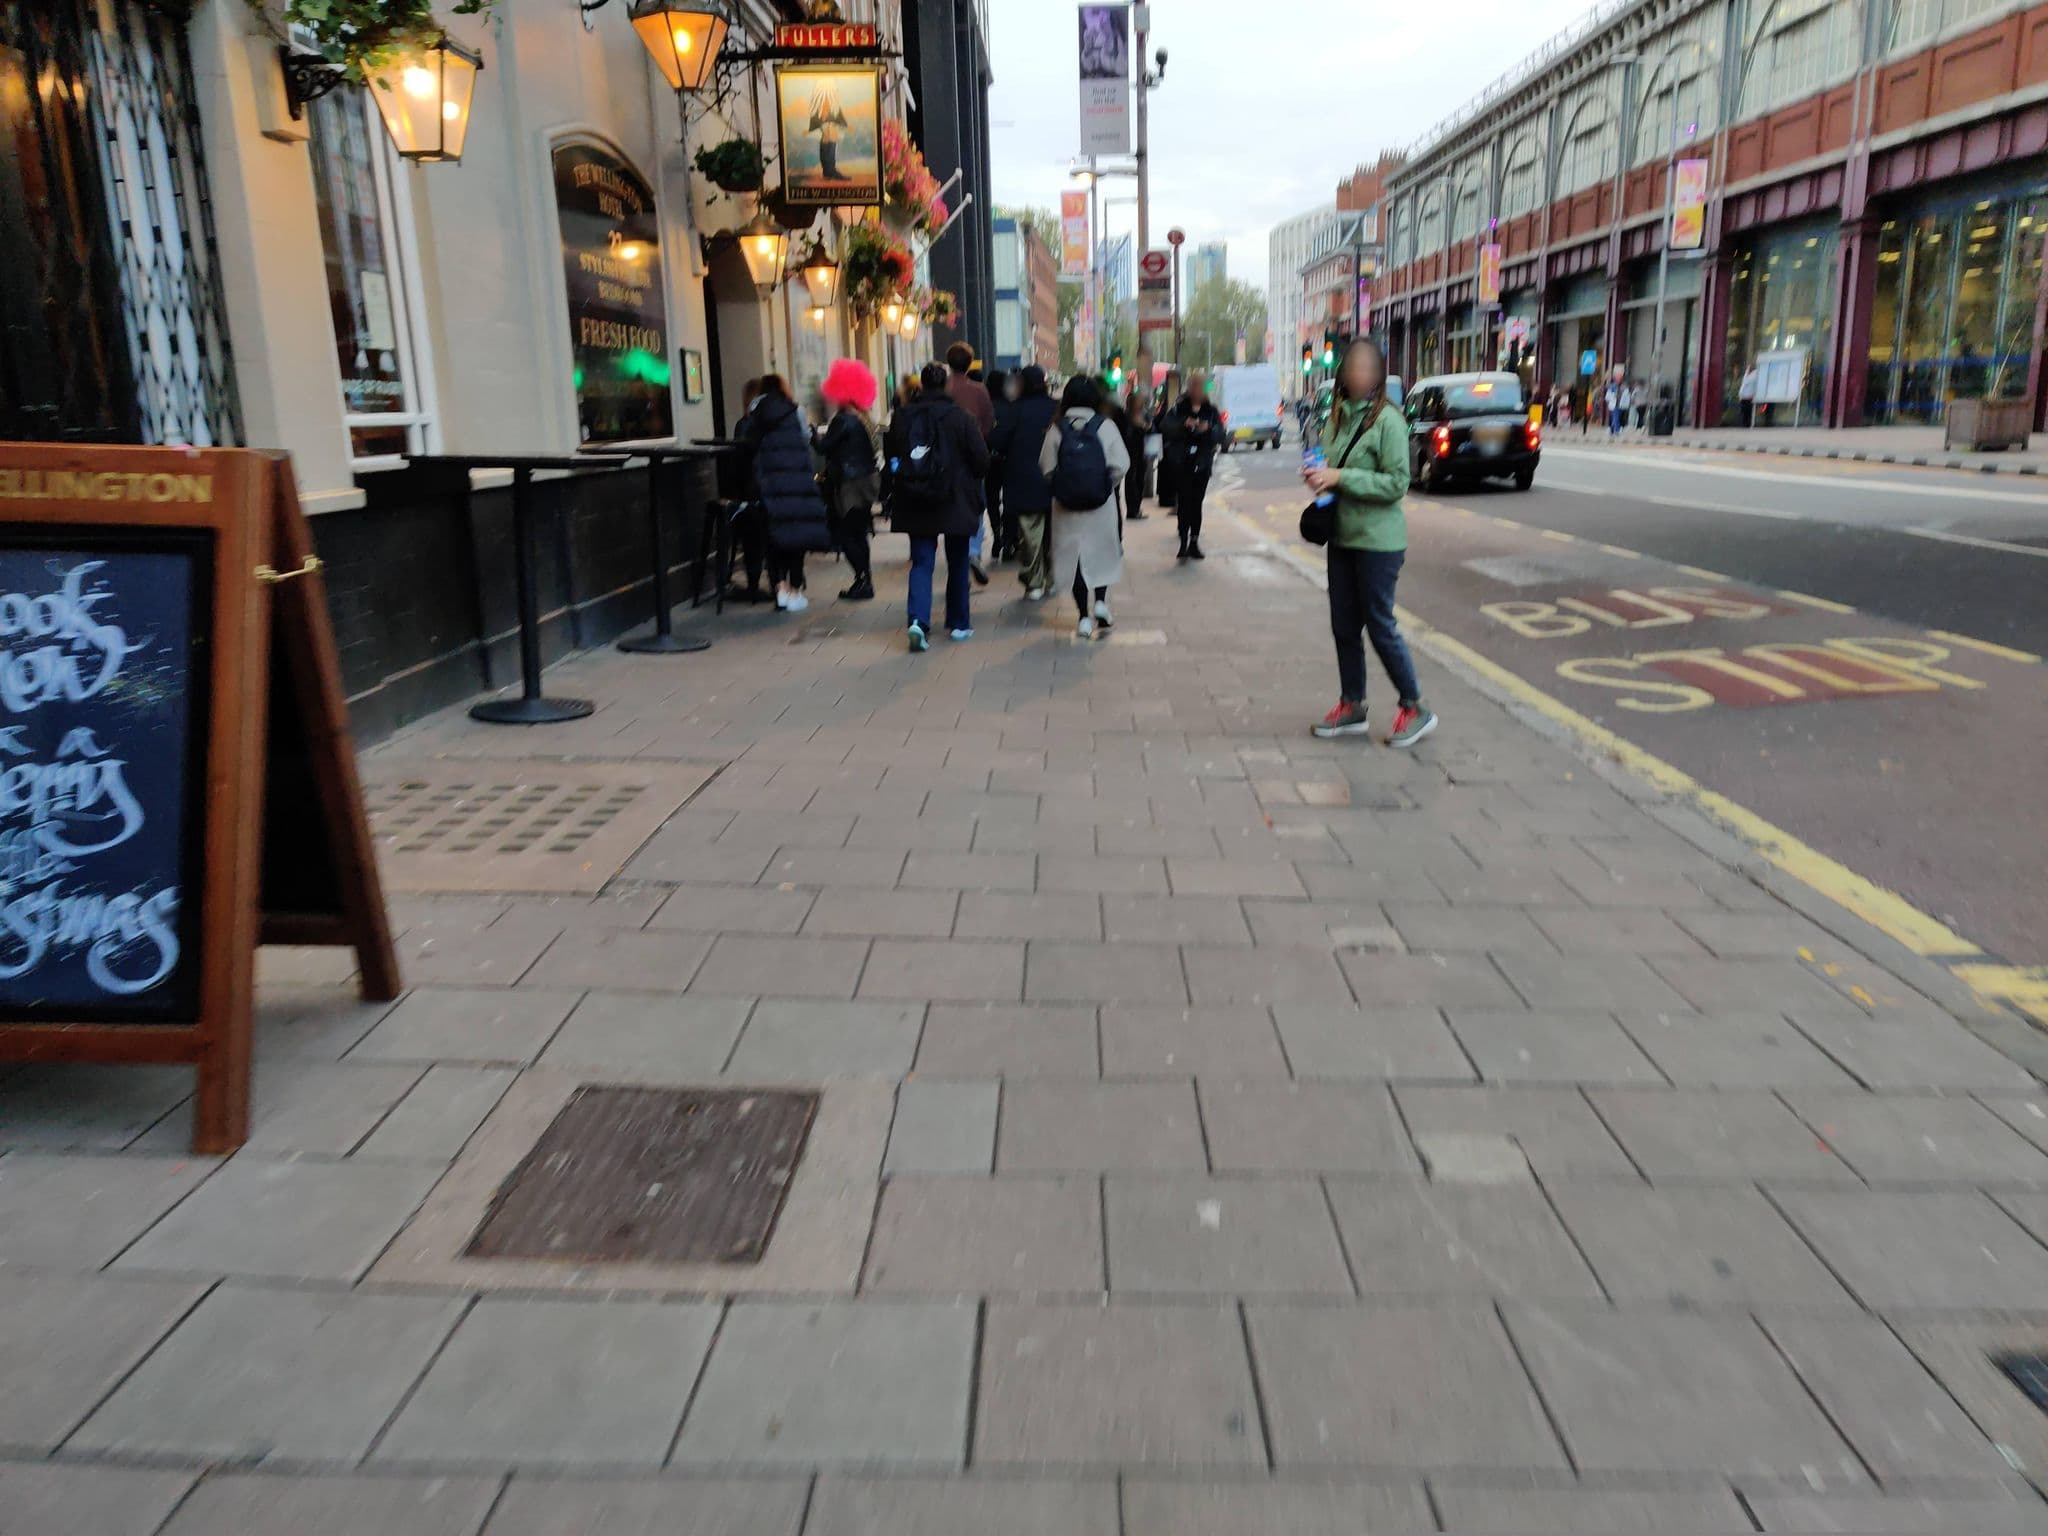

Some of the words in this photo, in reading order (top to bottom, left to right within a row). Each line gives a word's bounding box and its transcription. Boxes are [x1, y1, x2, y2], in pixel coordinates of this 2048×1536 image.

[580, 317, 628, 350] FRESH
[629, 325, 661, 355] FOOD
[1479, 586, 1771, 639] BUS
[1555, 637, 1987, 712] STOP
